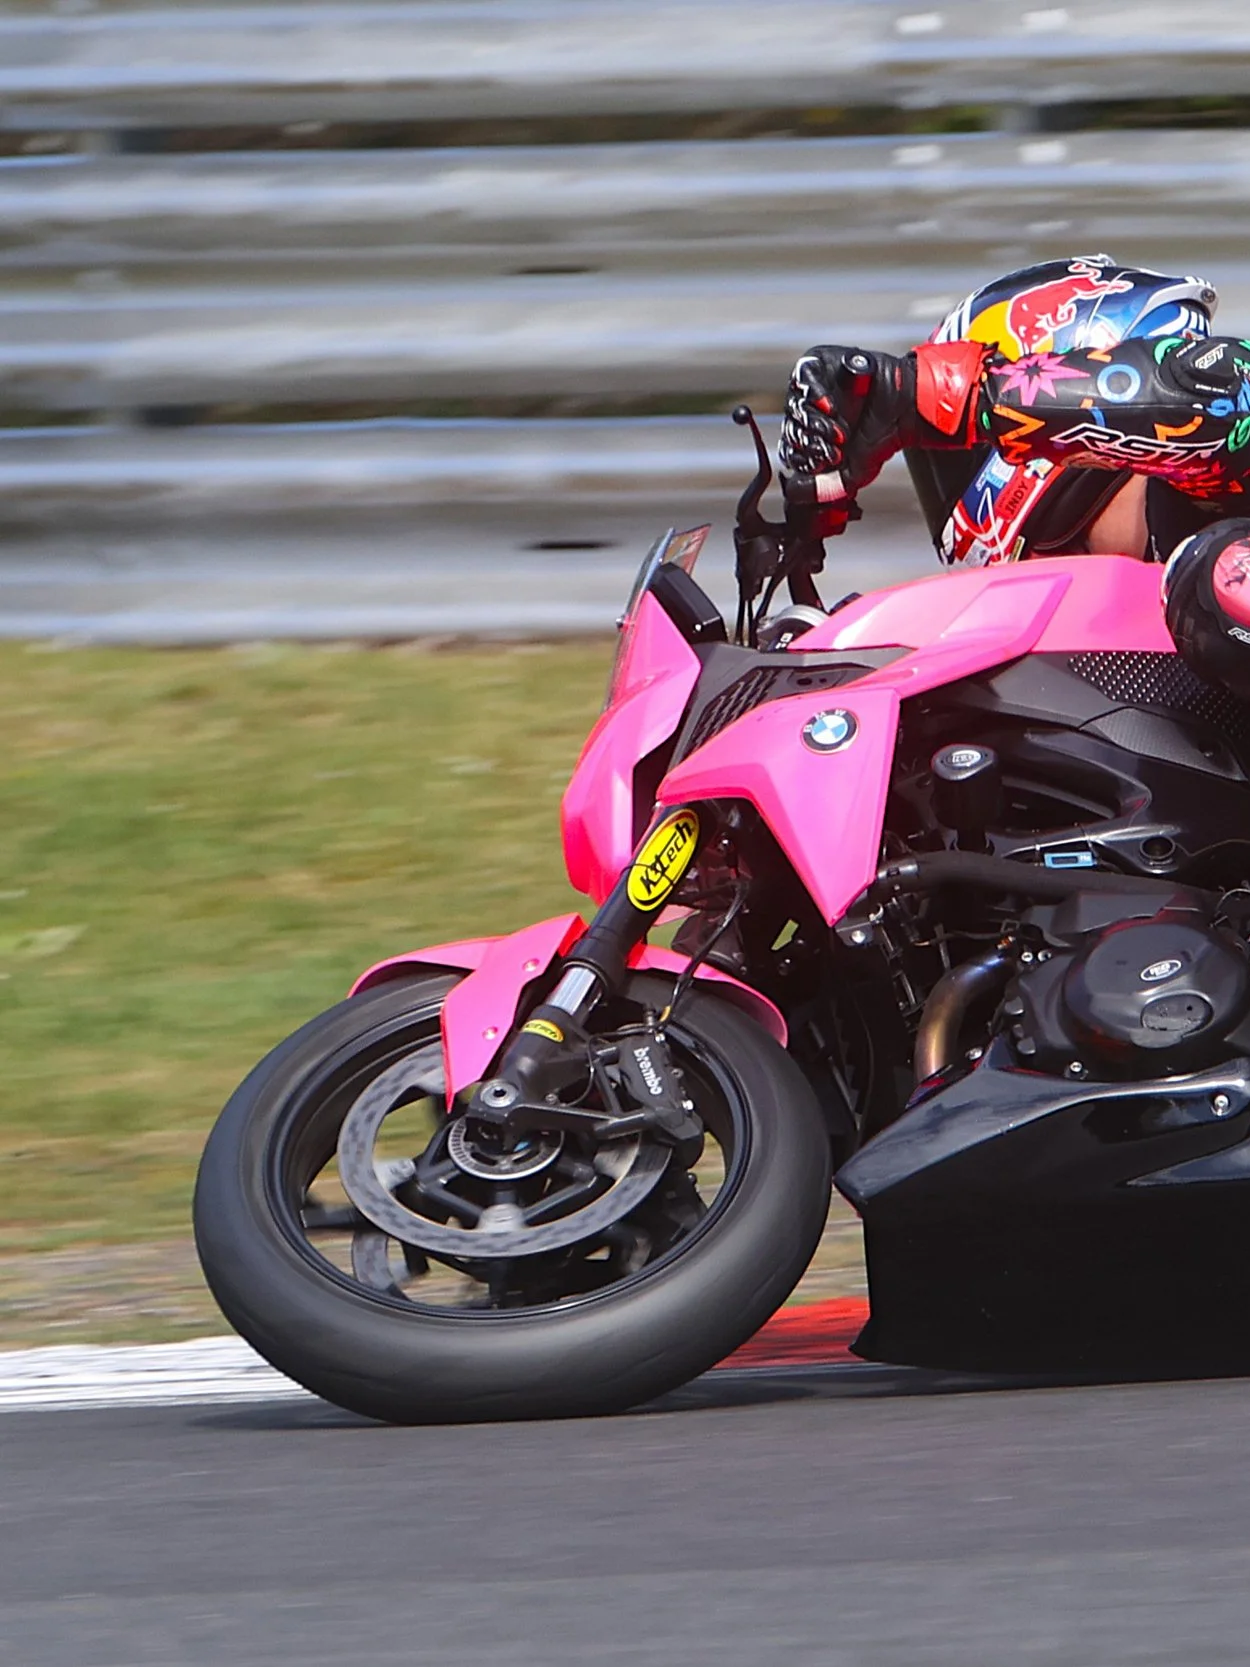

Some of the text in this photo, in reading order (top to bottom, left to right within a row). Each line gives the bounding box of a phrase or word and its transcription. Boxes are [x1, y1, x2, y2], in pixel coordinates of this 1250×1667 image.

[1194, 343, 1229, 370] RST
[1049, 422, 1227, 466] RST
[1004, 480, 1029, 515] INDY
[803, 709, 847, 733] BMW
[633, 1046, 663, 1095] brembo
